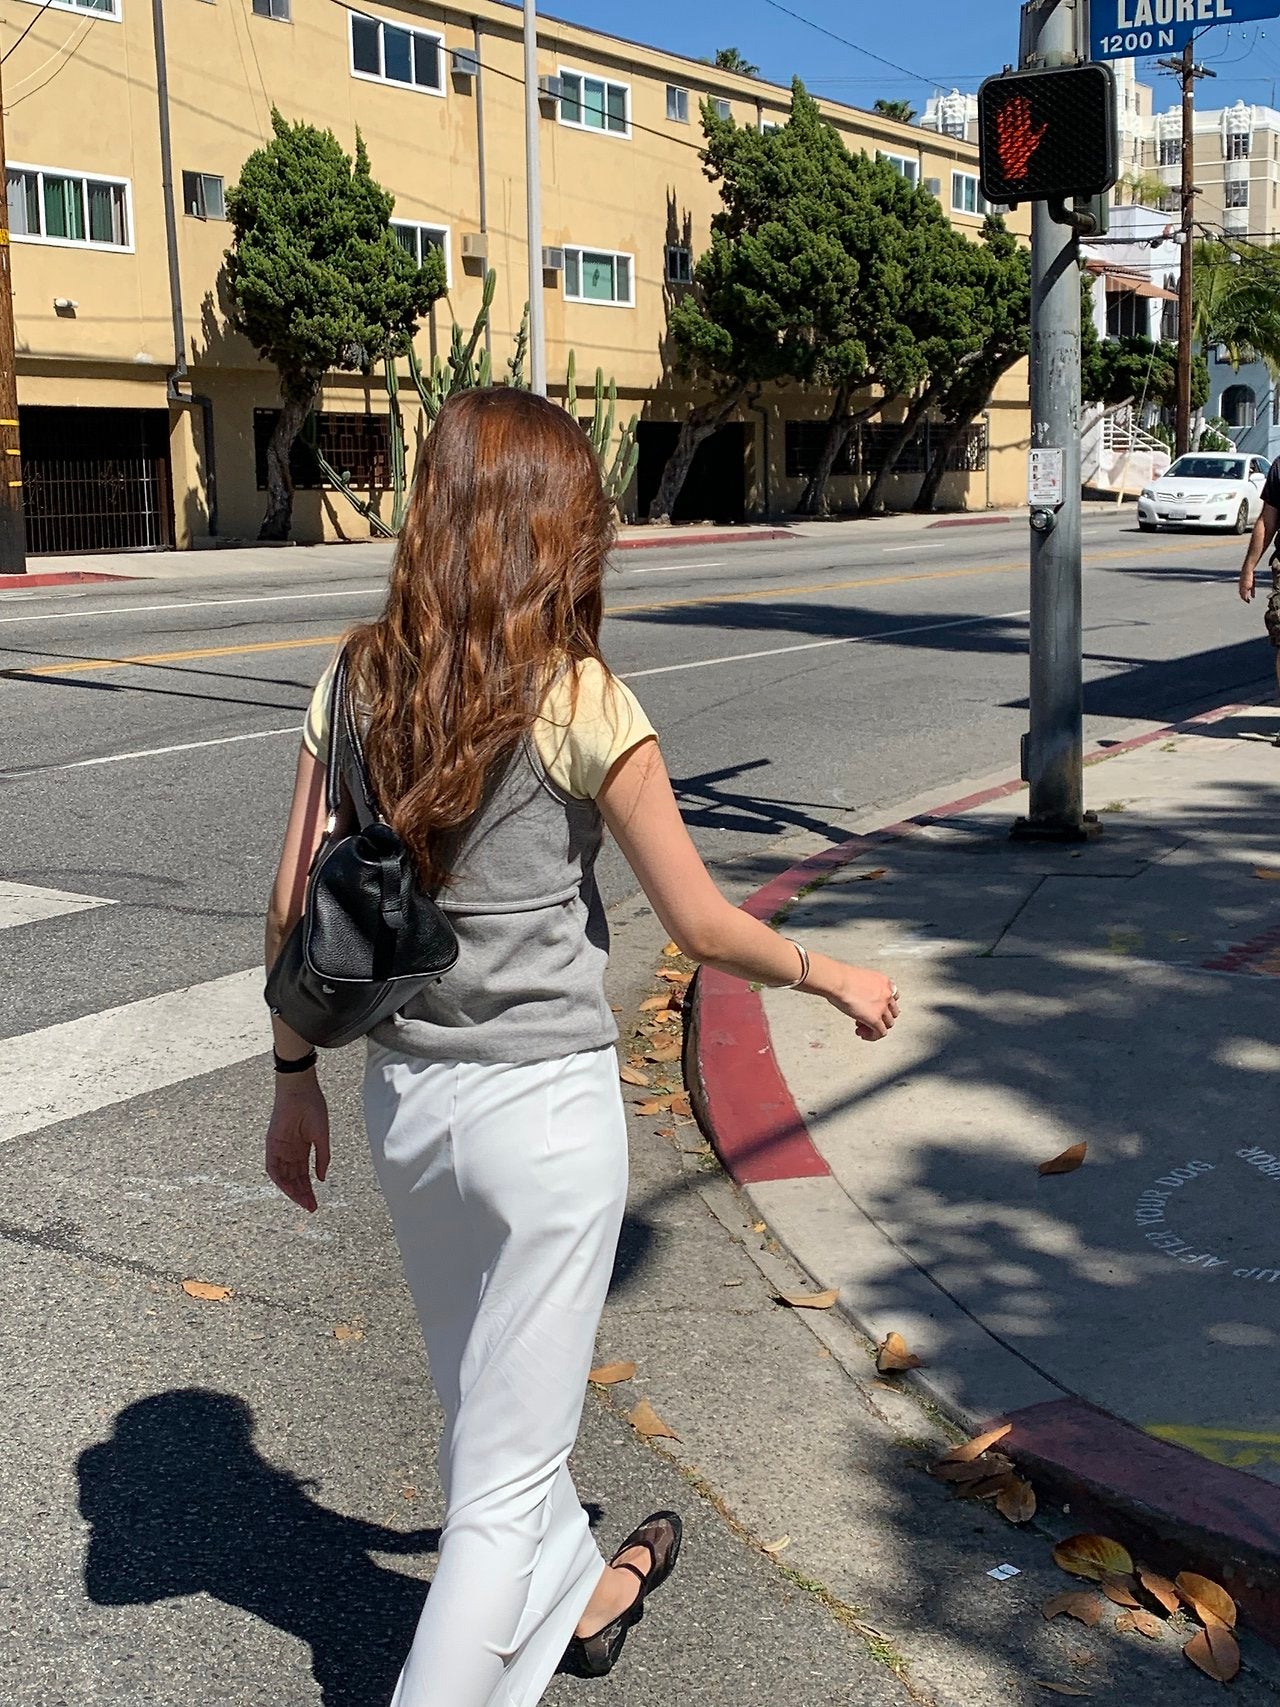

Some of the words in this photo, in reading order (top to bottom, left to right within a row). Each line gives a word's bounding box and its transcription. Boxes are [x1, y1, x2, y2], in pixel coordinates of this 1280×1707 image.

[1118, 0, 1233, 29] LAUREL
[1100, 32, 1153, 54] 1200
[1158, 29, 1174, 47] N
[1155, 1160, 1216, 1187] DOG
[1135, 1189, 1172, 1226] YOUR
[1145, 1230, 1229, 1268] AFTER
